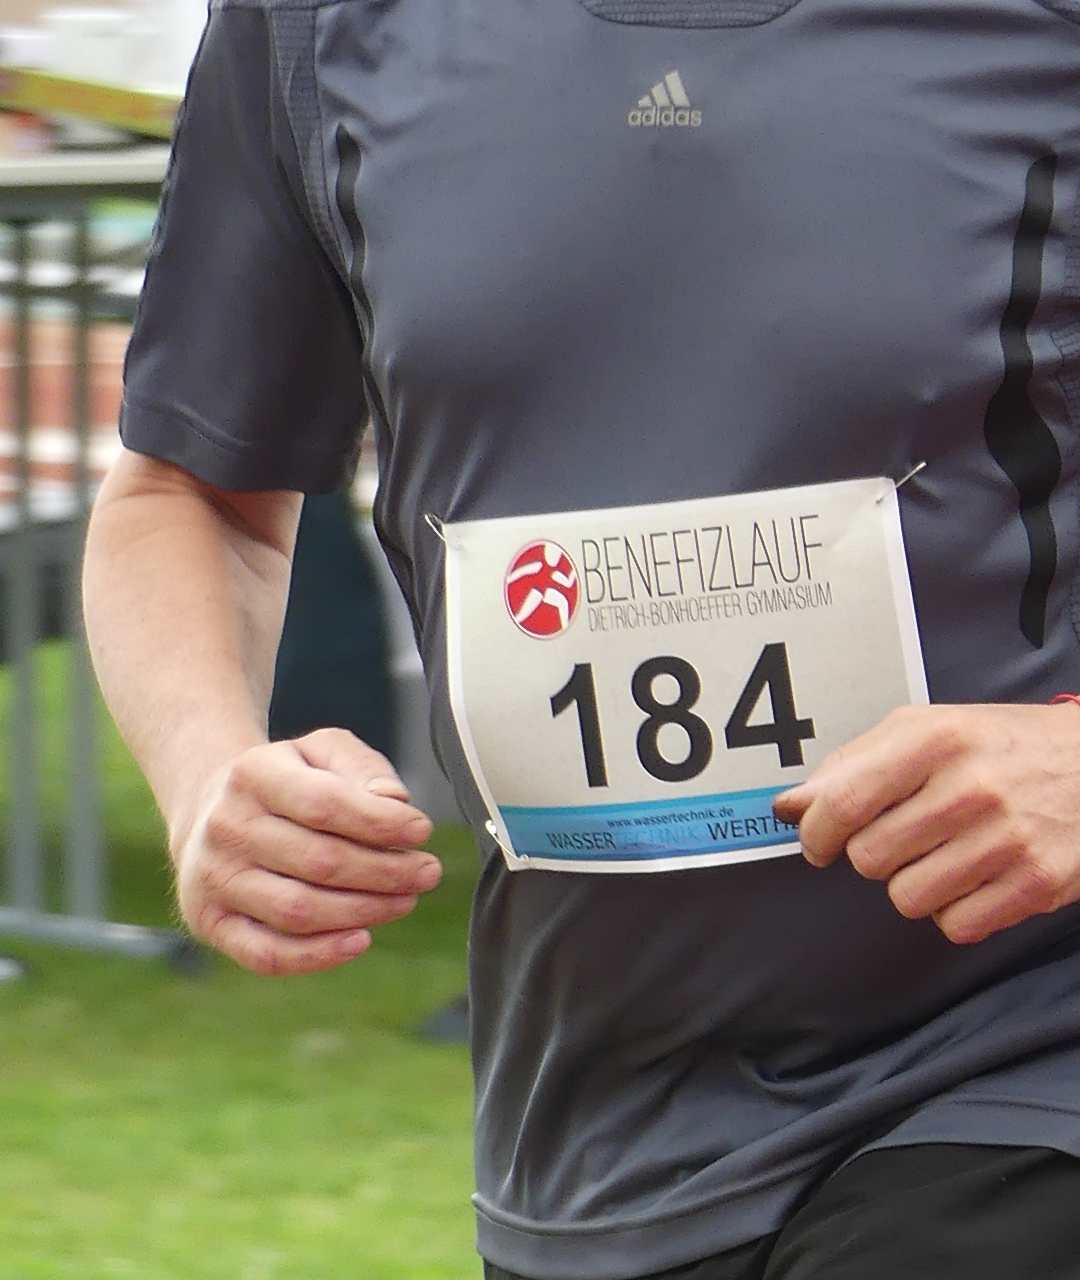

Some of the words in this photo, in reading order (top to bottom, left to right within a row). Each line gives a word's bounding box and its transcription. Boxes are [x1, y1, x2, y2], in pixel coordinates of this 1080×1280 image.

[627, 104, 702, 127] adidas
[581, 514, 823, 604] BENEFIZLAUF
[587, 592, 743, 633] DIETRICH-BONHOEFFER
[745, 581, 833, 617] GYMNASIUM
[549, 641, 817, 789] 184
[607, 806, 735, 829] www.wassertechnik.de
[707, 813, 799, 841] WERTH
